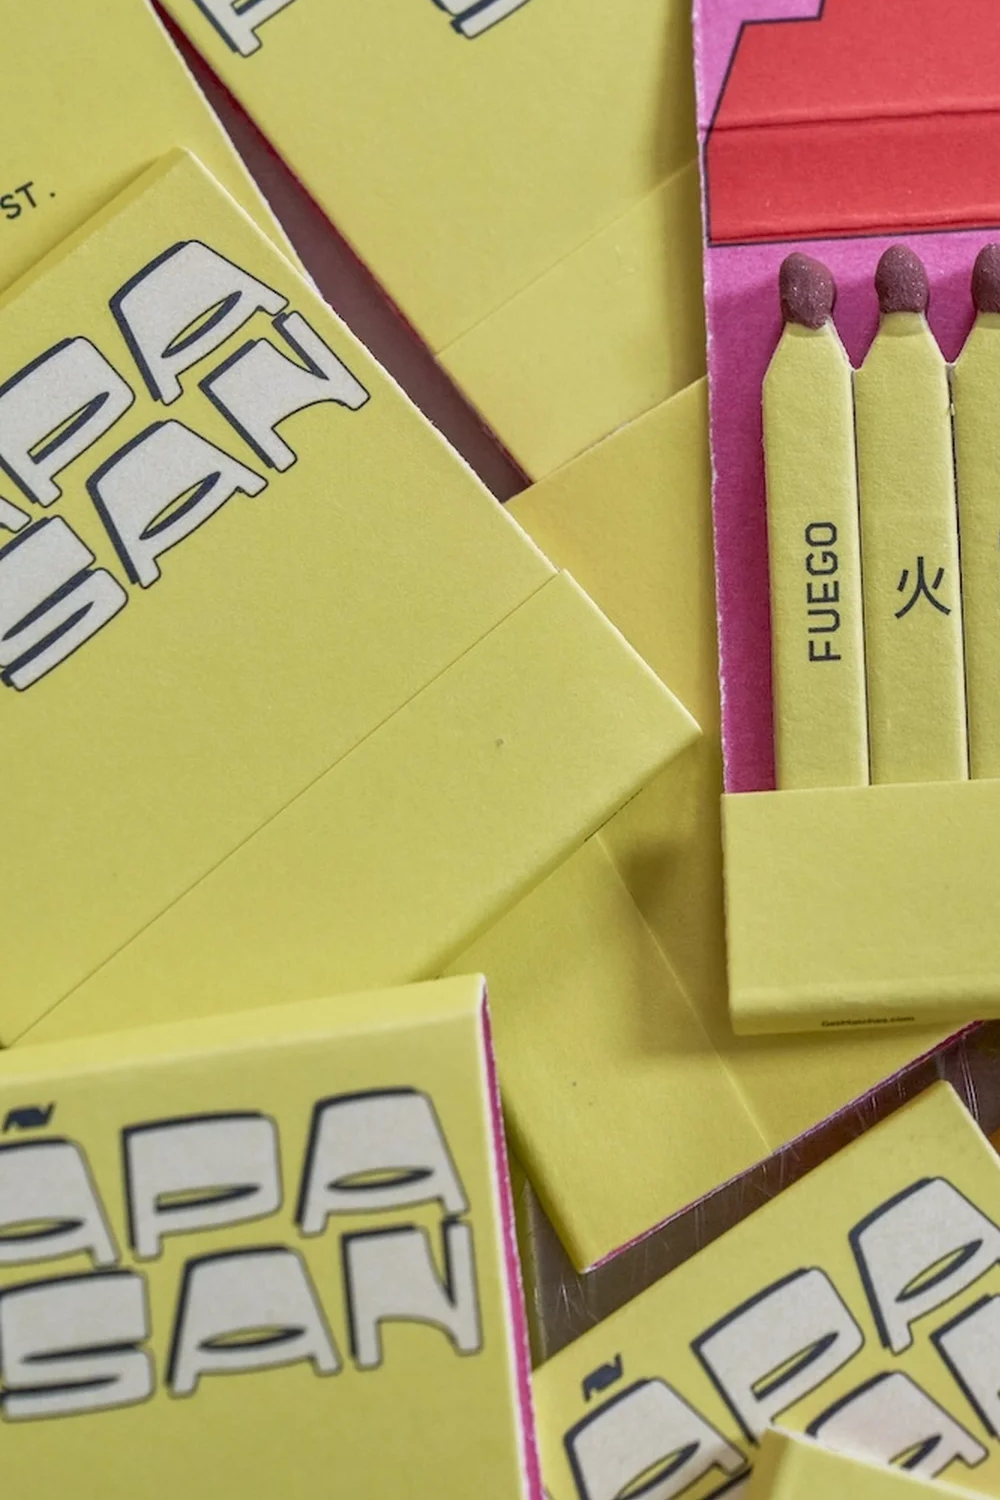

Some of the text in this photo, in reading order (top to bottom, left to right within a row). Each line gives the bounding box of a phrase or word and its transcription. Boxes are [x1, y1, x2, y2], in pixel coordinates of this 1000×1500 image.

[0, 180, 56, 220] ST.
[0, 240, 289, 534] PA
[0, 310, 371, 692] SAN
[804, 521, 842, 662] FUEGO
[894, 556, 952, 619] 火
[0, 1085, 469, 1270] ÃPA
[0, 1215, 482, 1421] SAN
